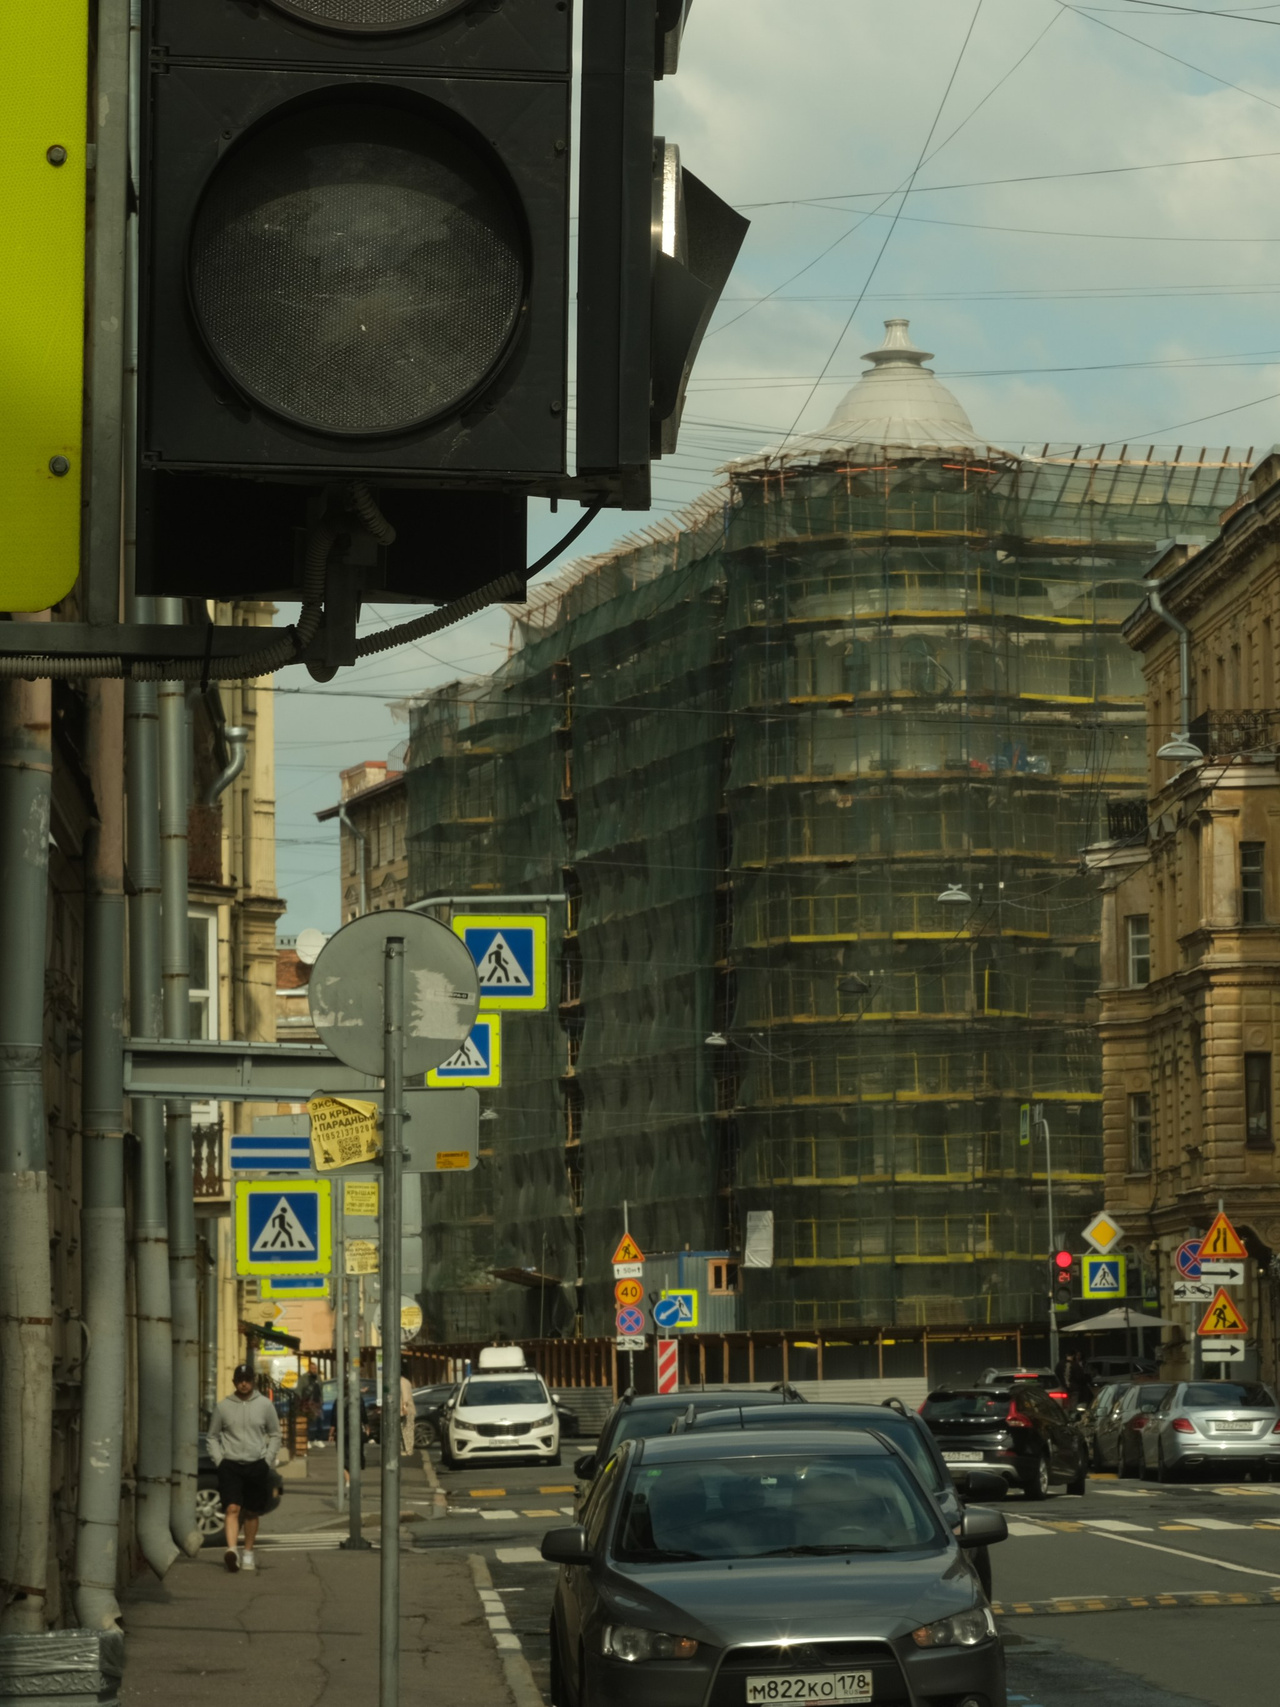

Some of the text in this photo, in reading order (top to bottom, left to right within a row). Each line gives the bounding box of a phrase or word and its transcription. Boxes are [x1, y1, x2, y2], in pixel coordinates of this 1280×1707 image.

[313, 1113, 326, 1122] ПО
[1058, 1271, 1071, 1283] 24
[621, 1287, 638, 1297] 40
[837, 1674, 867, 1690] 178
